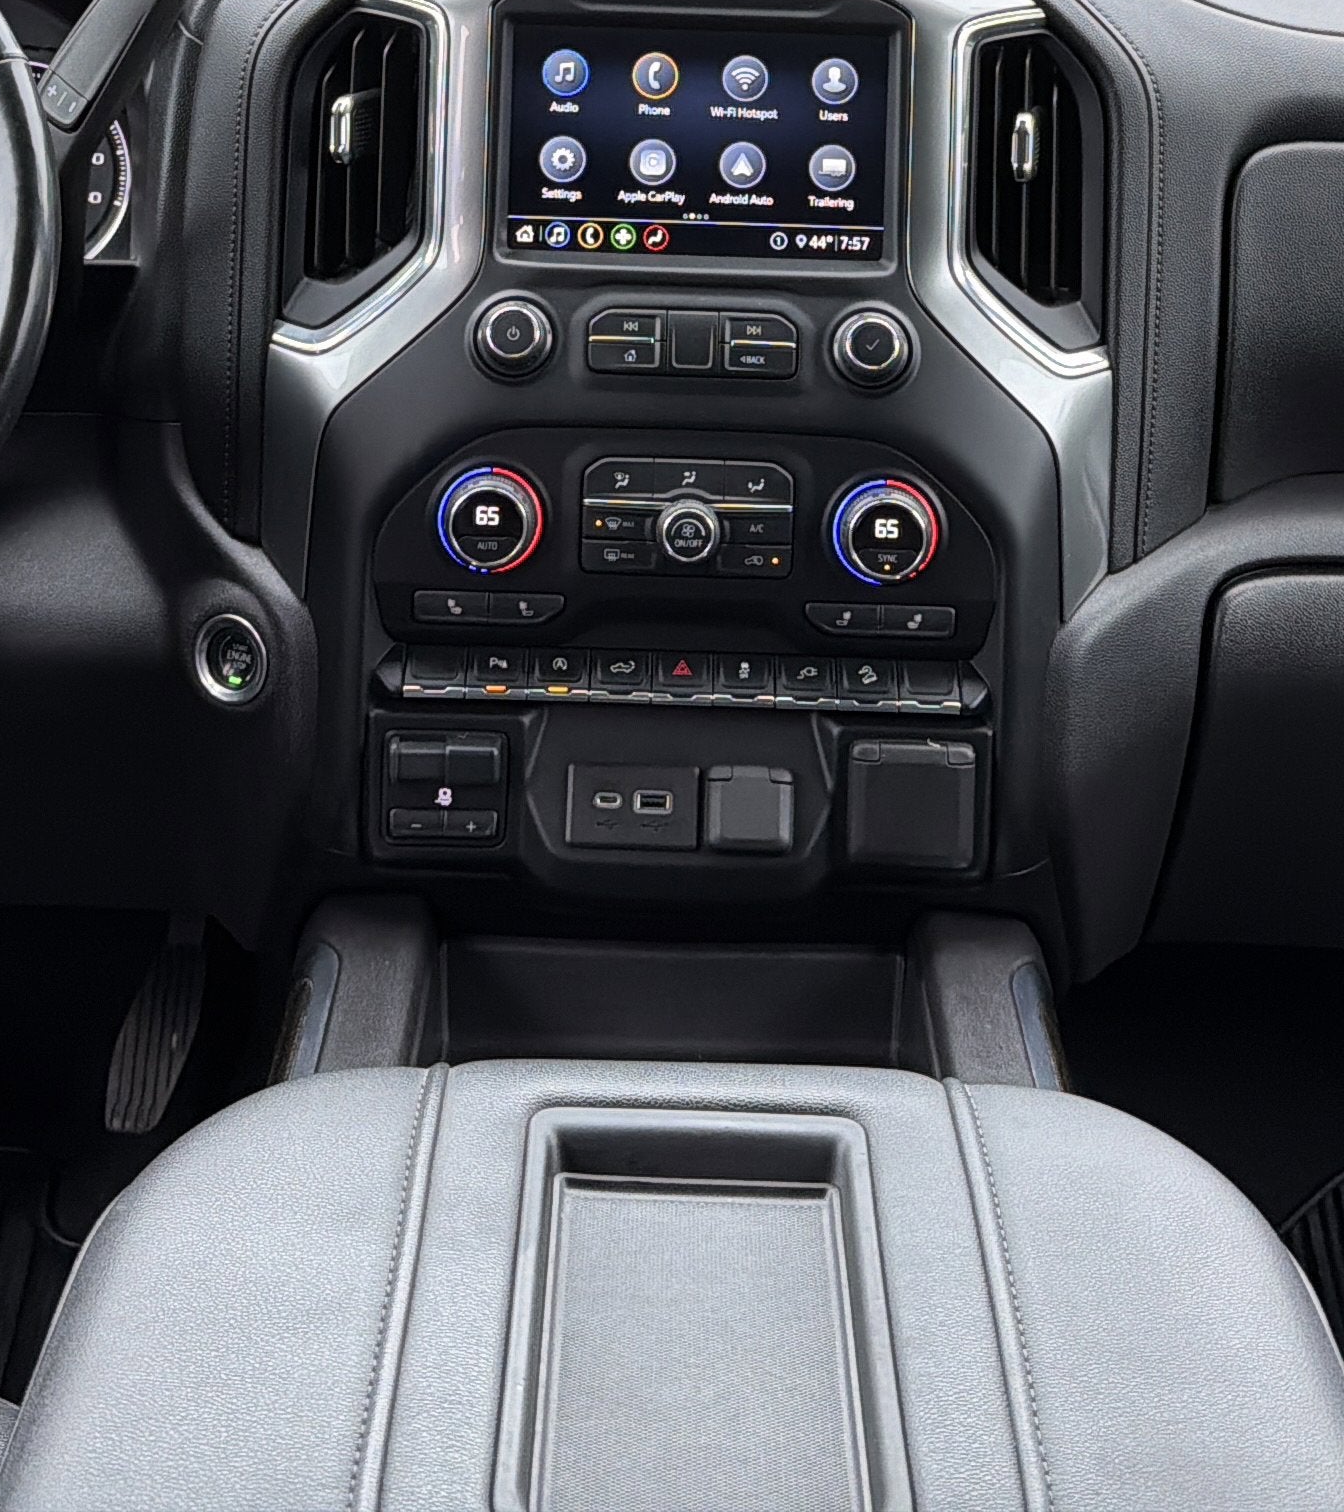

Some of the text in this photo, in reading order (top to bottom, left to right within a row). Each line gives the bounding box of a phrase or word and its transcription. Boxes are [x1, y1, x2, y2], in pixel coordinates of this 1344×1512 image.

[549, 101, 579, 113] Audio
[638, 103, 671, 116] Phone
[710, 106, 778, 121] Wi-Fi Hotspot
[818, 109, 849, 122] Users
[541, 186, 583, 202] Settings
[617, 190, 685, 205] Apple CarPlay
[709, 193, 774, 206] Android Auto
[808, 195, 855, 210] Trailering
[809, 234, 834, 249] 44°
[839, 235, 871, 251] 7:57
[746, 354, 765, 365] BACK
[475, 506, 499, 527] 65
[749, 524, 764, 533] A/C
[874, 519, 899, 539] 65
[477, 540, 498, 551] AUTO
[674, 539, 703, 548] ON/OFF
[877, 553, 898, 563] SYNC
